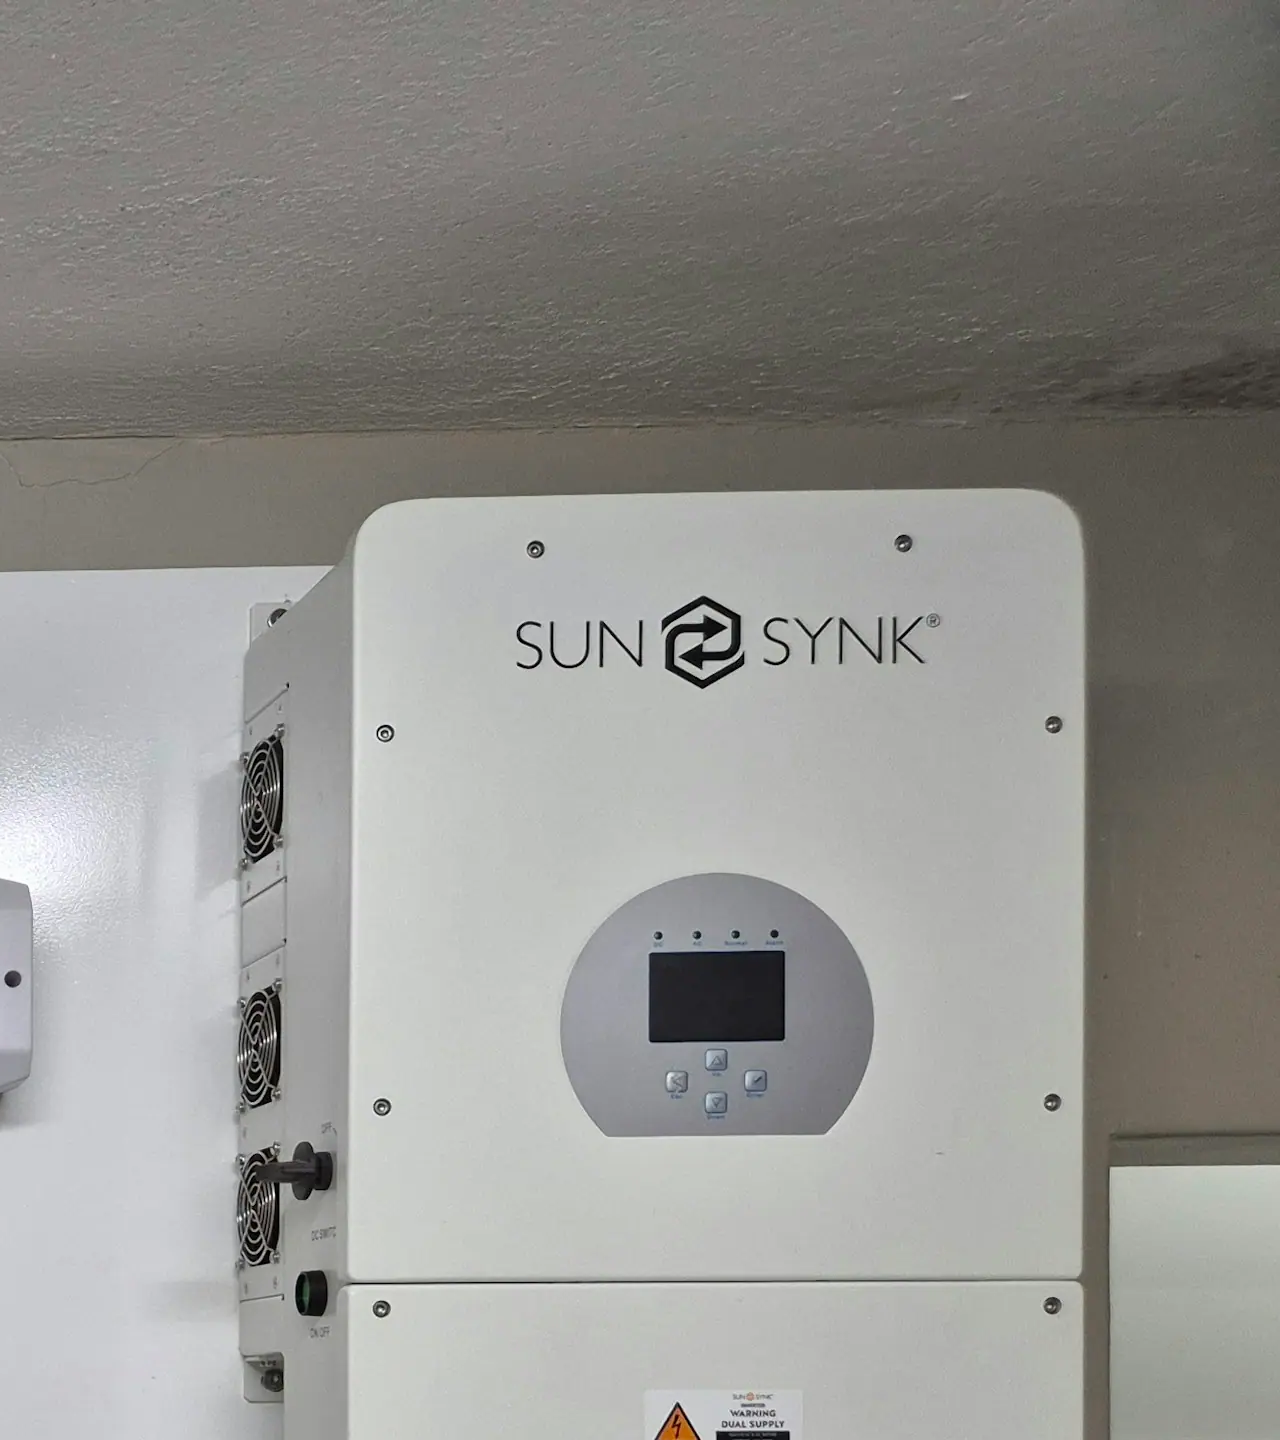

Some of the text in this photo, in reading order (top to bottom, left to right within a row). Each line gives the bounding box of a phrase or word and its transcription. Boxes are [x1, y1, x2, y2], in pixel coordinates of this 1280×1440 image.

[516, 620, 644, 669] SUN
[730, 1409, 777, 1417] WARNING
[721, 1420, 785, 1428] DUAL SUPPLY
